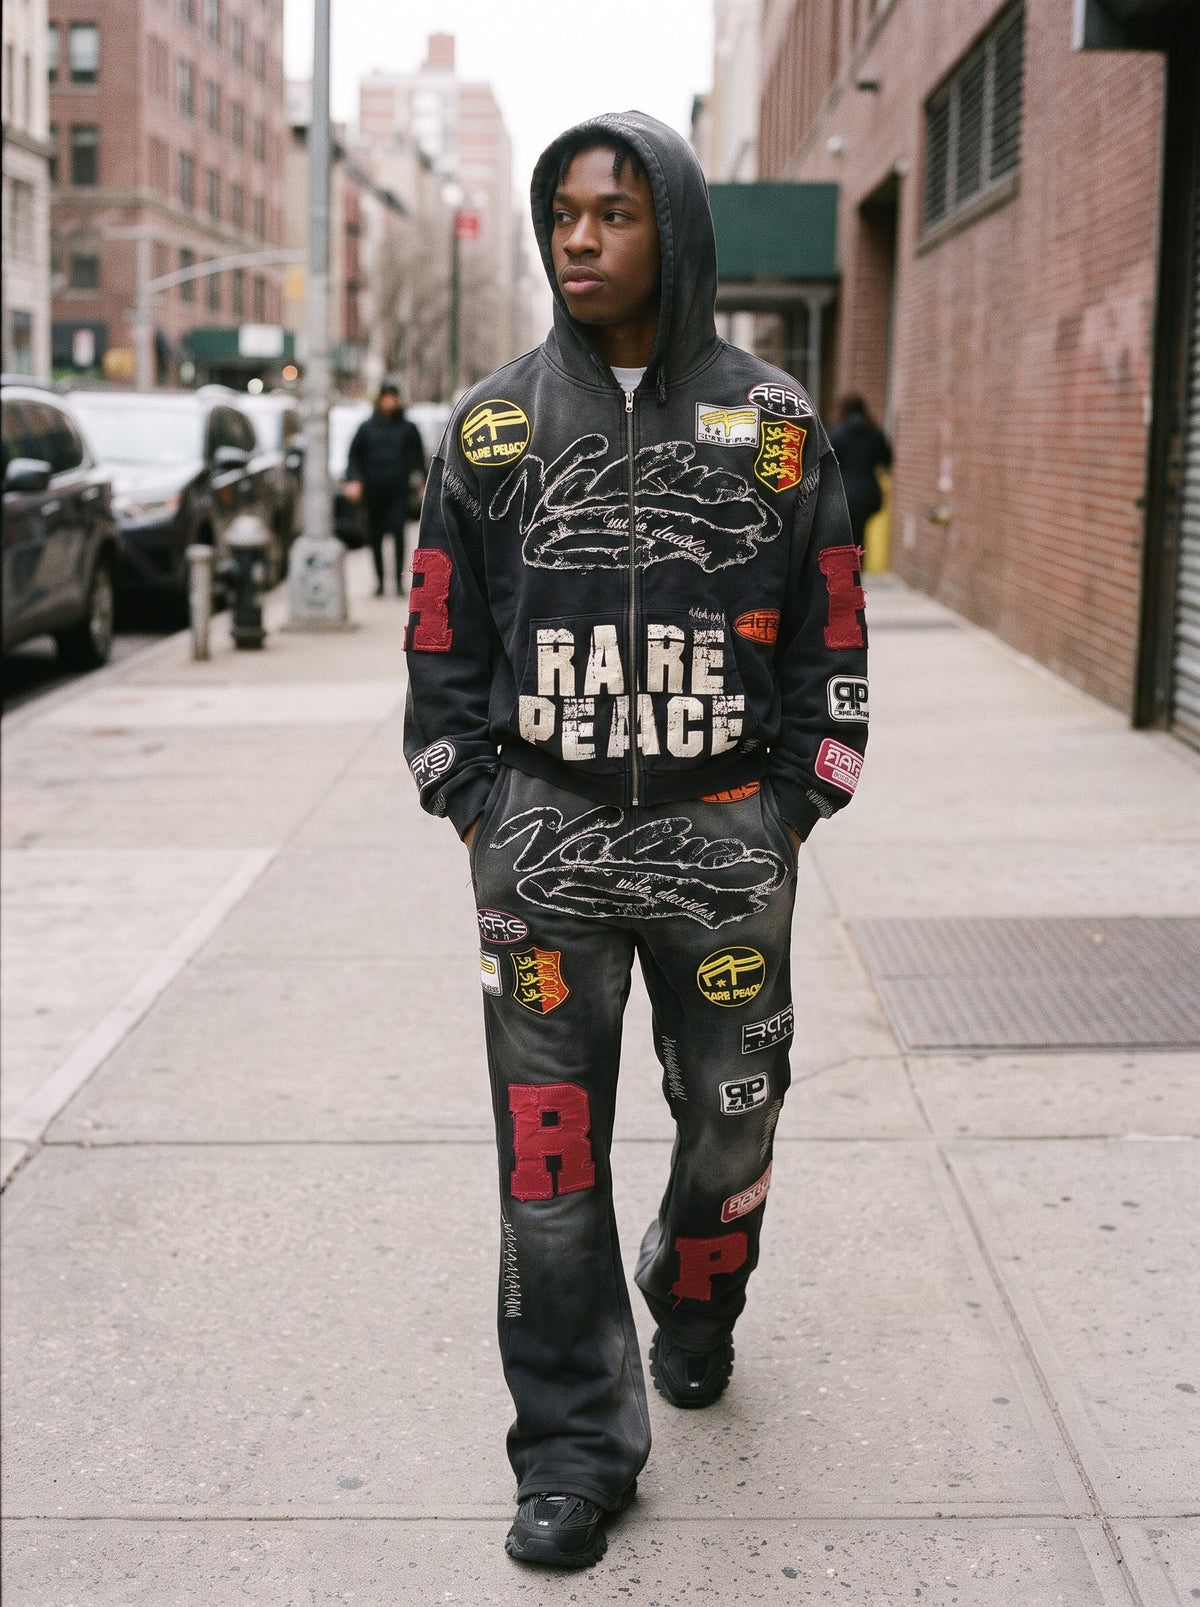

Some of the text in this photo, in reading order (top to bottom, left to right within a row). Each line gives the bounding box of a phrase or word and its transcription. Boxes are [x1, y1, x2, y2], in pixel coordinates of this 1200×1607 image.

[537, 624, 725, 696] RARE
[518, 694, 745, 761] PEACE
[507, 1081, 596, 1202] R
[671, 1231, 748, 1302] P
